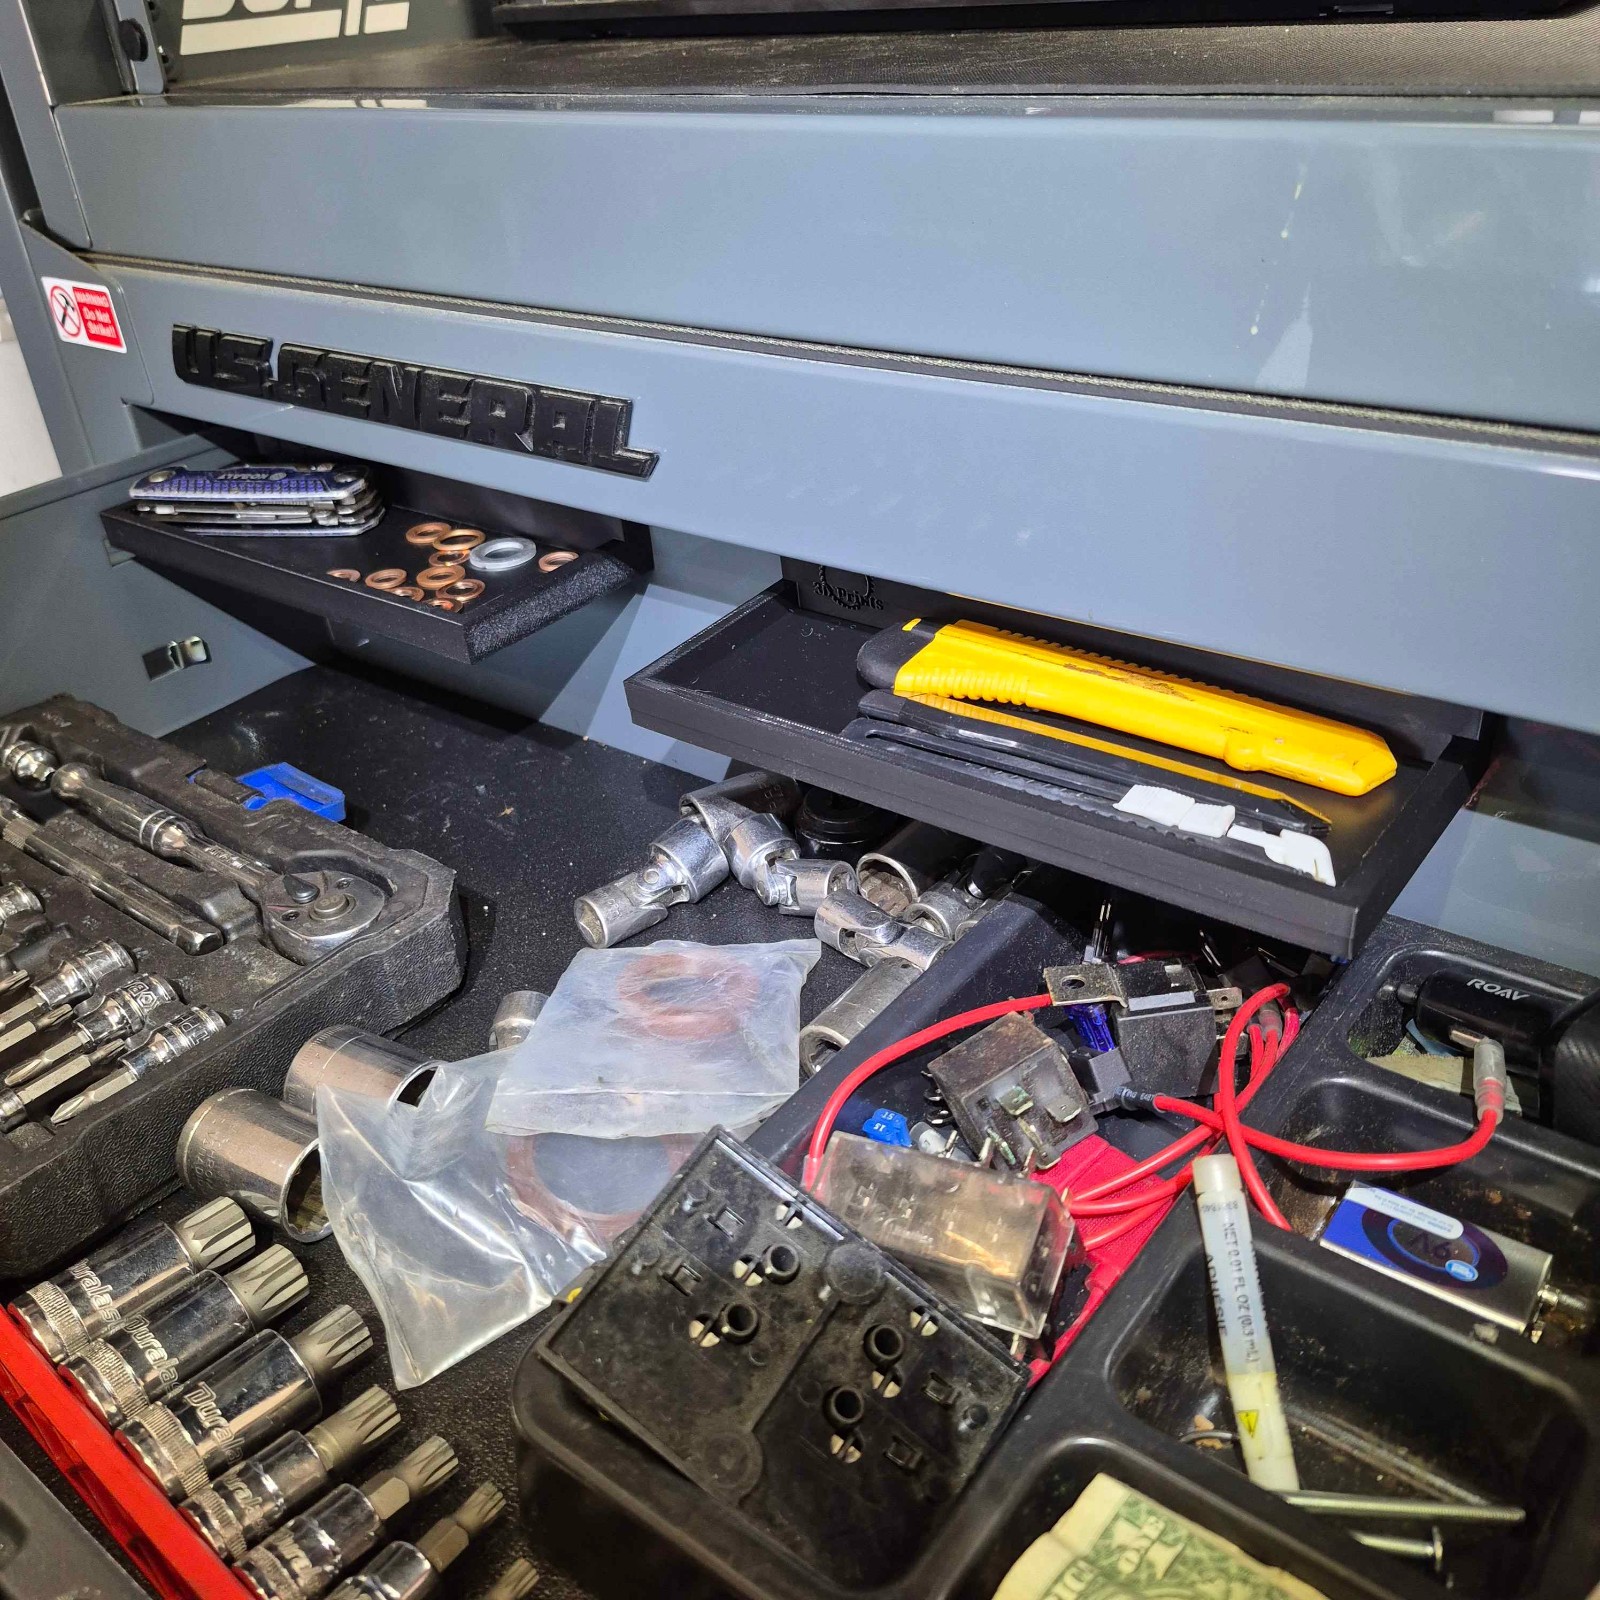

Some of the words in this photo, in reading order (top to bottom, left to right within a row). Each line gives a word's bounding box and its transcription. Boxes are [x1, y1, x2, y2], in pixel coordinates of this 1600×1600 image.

[1466, 978, 1531, 1001] ROAV
[1222, 1221, 1238, 1247] NET
[1233, 1273, 1246, 1291] FL
[1236, 1293, 1250, 1316] OZ
